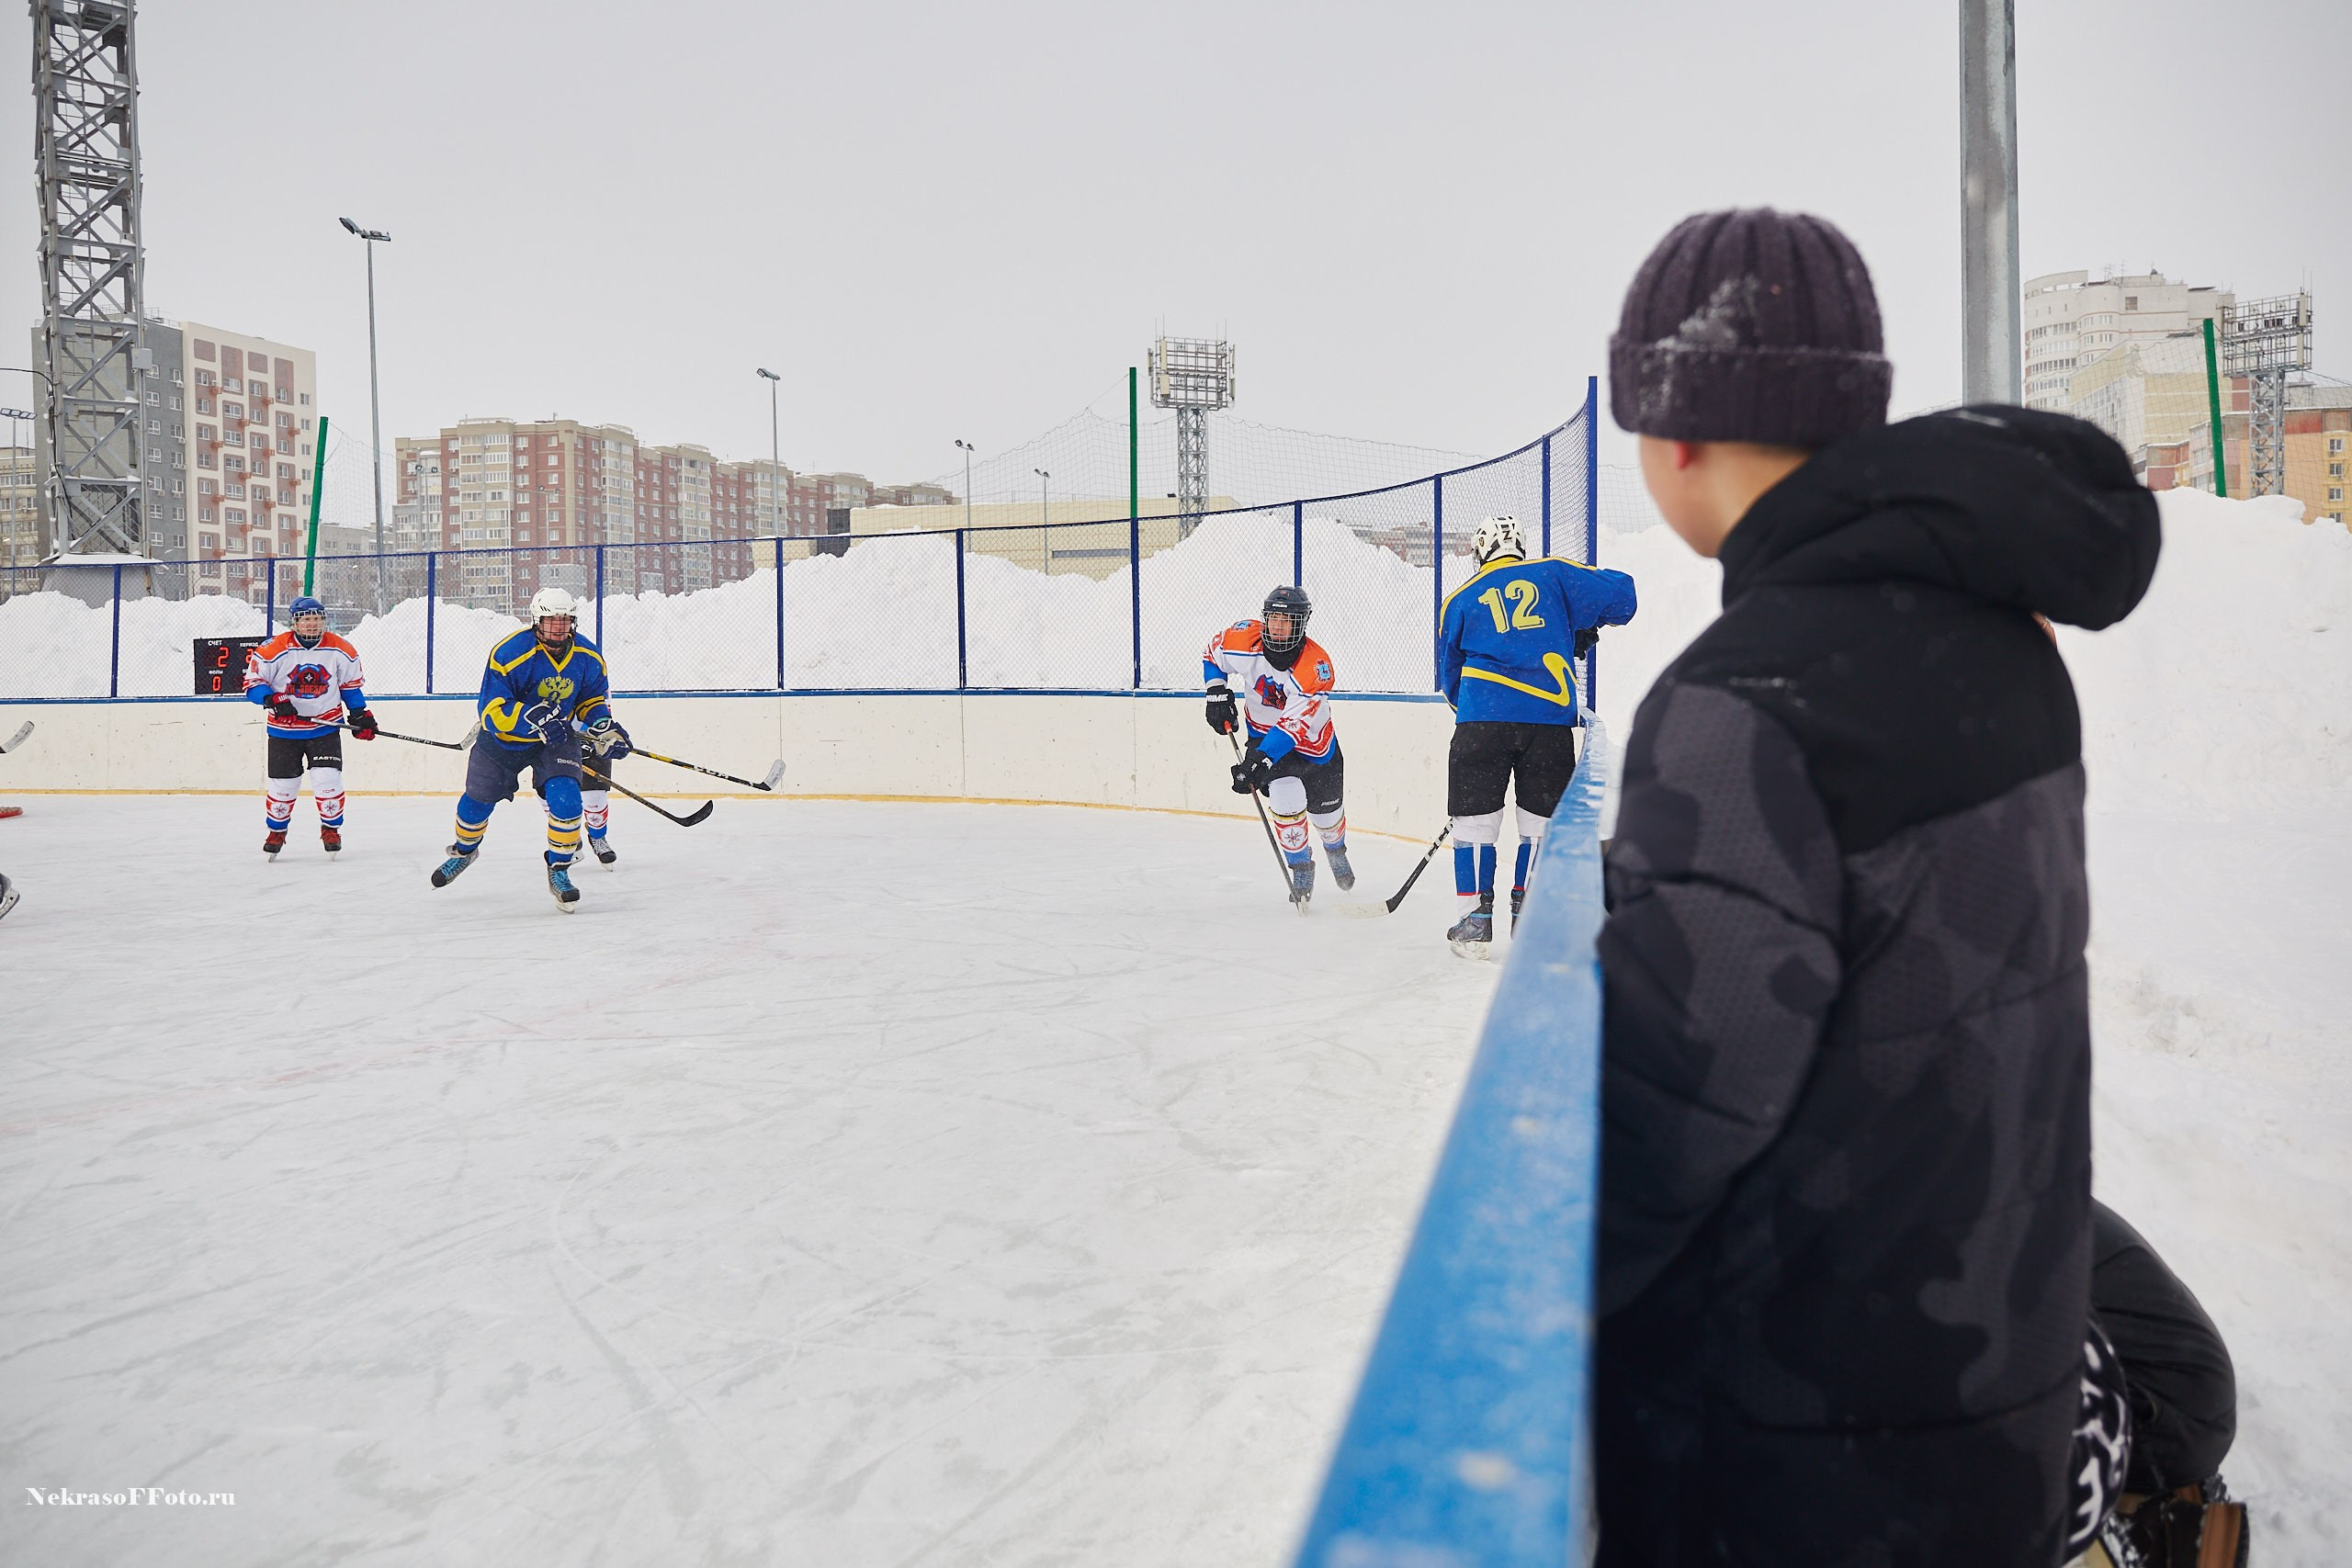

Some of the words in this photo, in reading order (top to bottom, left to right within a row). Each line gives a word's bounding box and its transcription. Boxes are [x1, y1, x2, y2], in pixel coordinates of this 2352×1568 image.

[1477, 579, 1545, 634] 12
[217, 647, 230, 668] 2
[212, 675, 221, 692] 0
